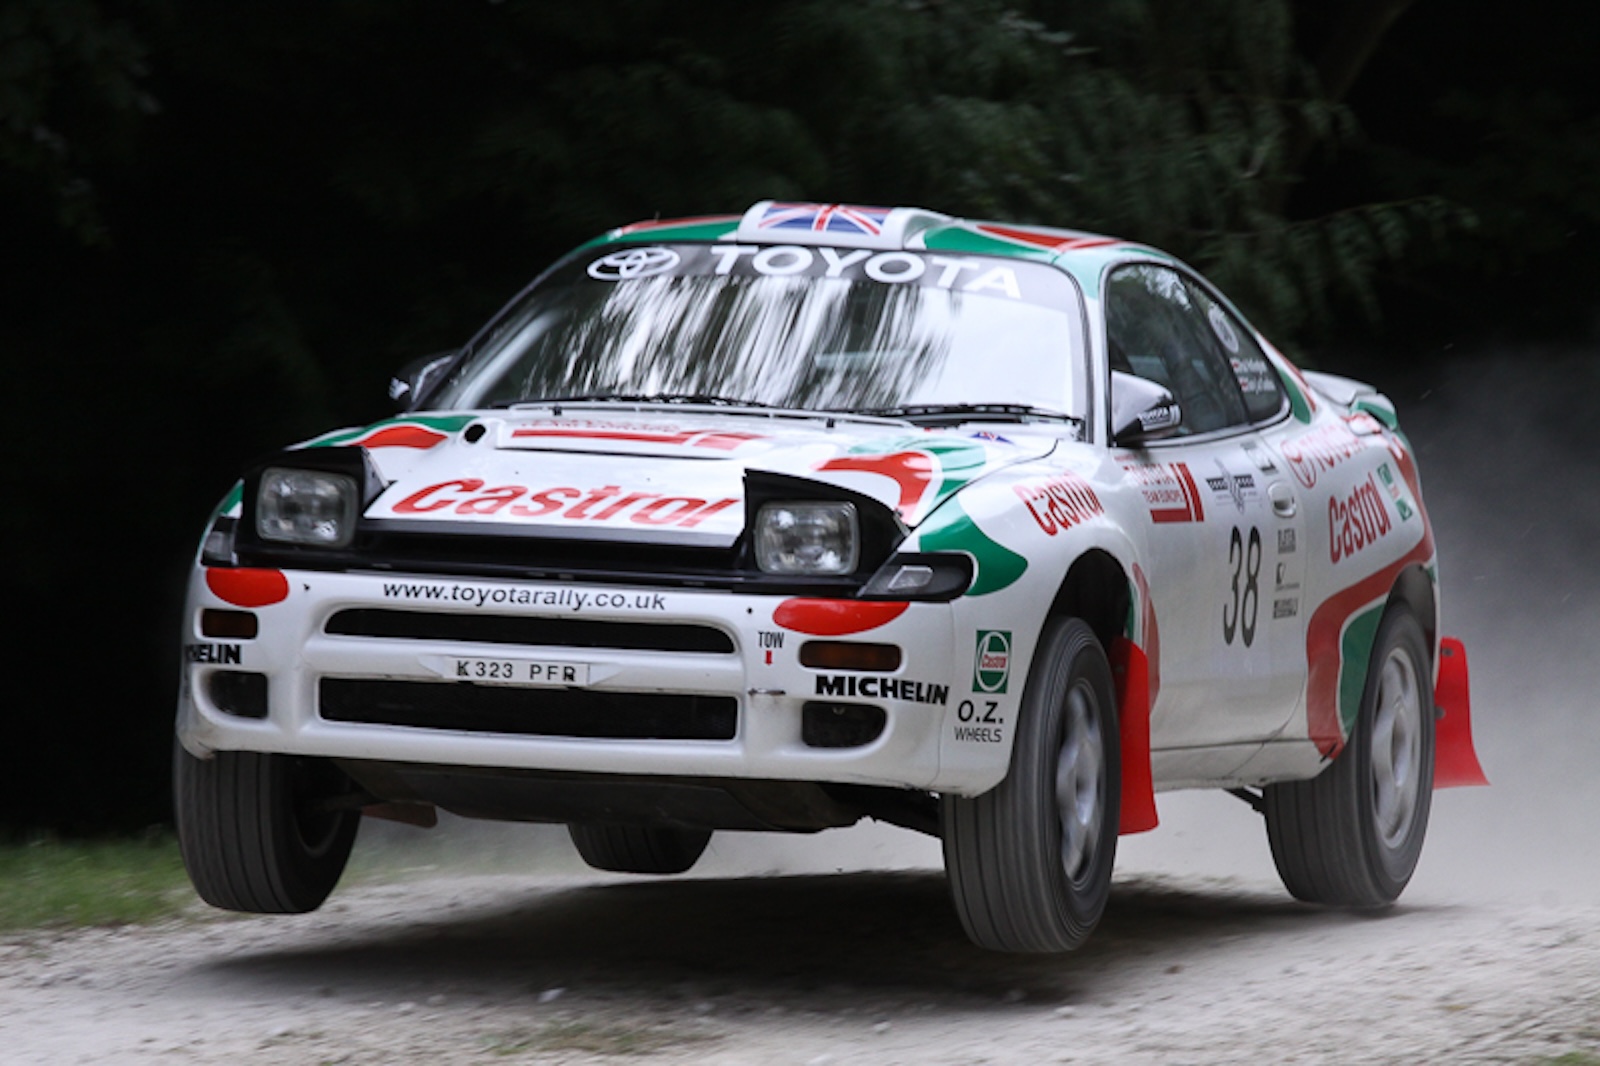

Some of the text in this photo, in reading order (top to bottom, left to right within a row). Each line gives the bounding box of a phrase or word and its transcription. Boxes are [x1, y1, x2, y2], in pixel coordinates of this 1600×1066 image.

[711, 244, 1022, 299] TOYOTA
[392, 478, 741, 528] Castrol
[1012, 471, 1105, 536] Castrol
[1328, 471, 1392, 564] Castrol
[383, 582, 666, 611] www.toyotarally.co.uk
[1223, 524, 1262, 649] 38
[758, 631, 785, 648] TOW
[530, 664, 576, 682] PFR
[816, 675, 949, 706] MICHELIN
[958, 700, 1004, 724] O.Z.
[954, 726, 1002, 743] WHEELS
